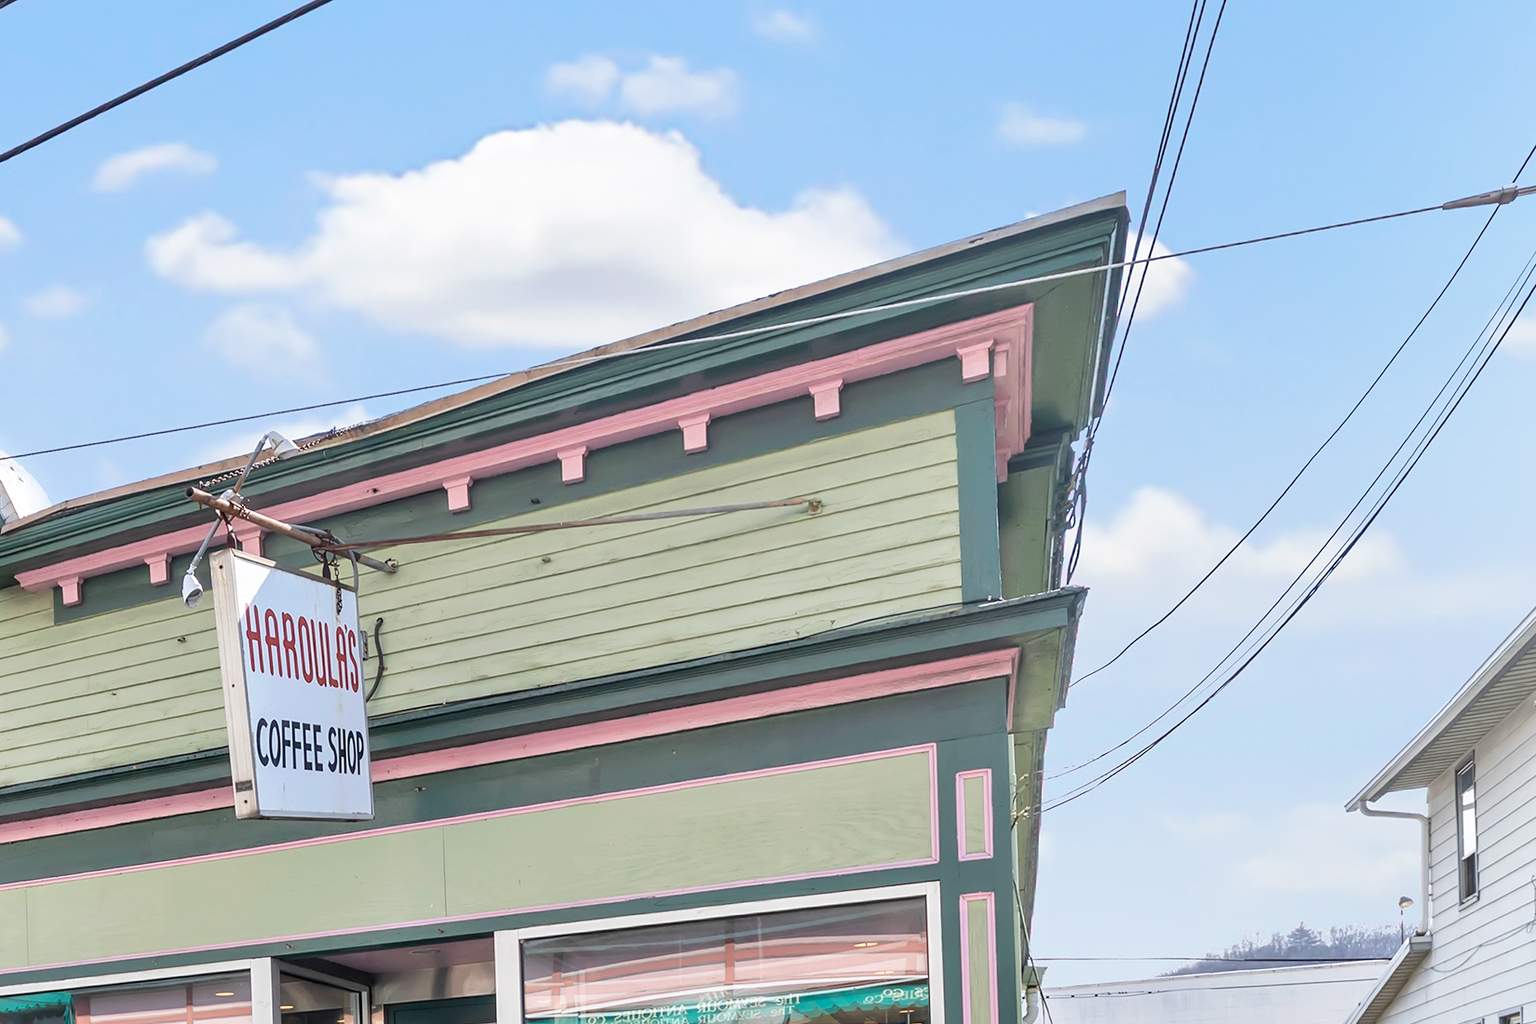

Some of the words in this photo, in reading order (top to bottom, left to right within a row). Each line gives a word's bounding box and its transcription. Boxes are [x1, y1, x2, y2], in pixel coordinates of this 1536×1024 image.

[245, 603, 359, 693] HAROULA'S
[256, 717, 324, 773] COFFEE
[328, 726, 364, 776] SHOP
